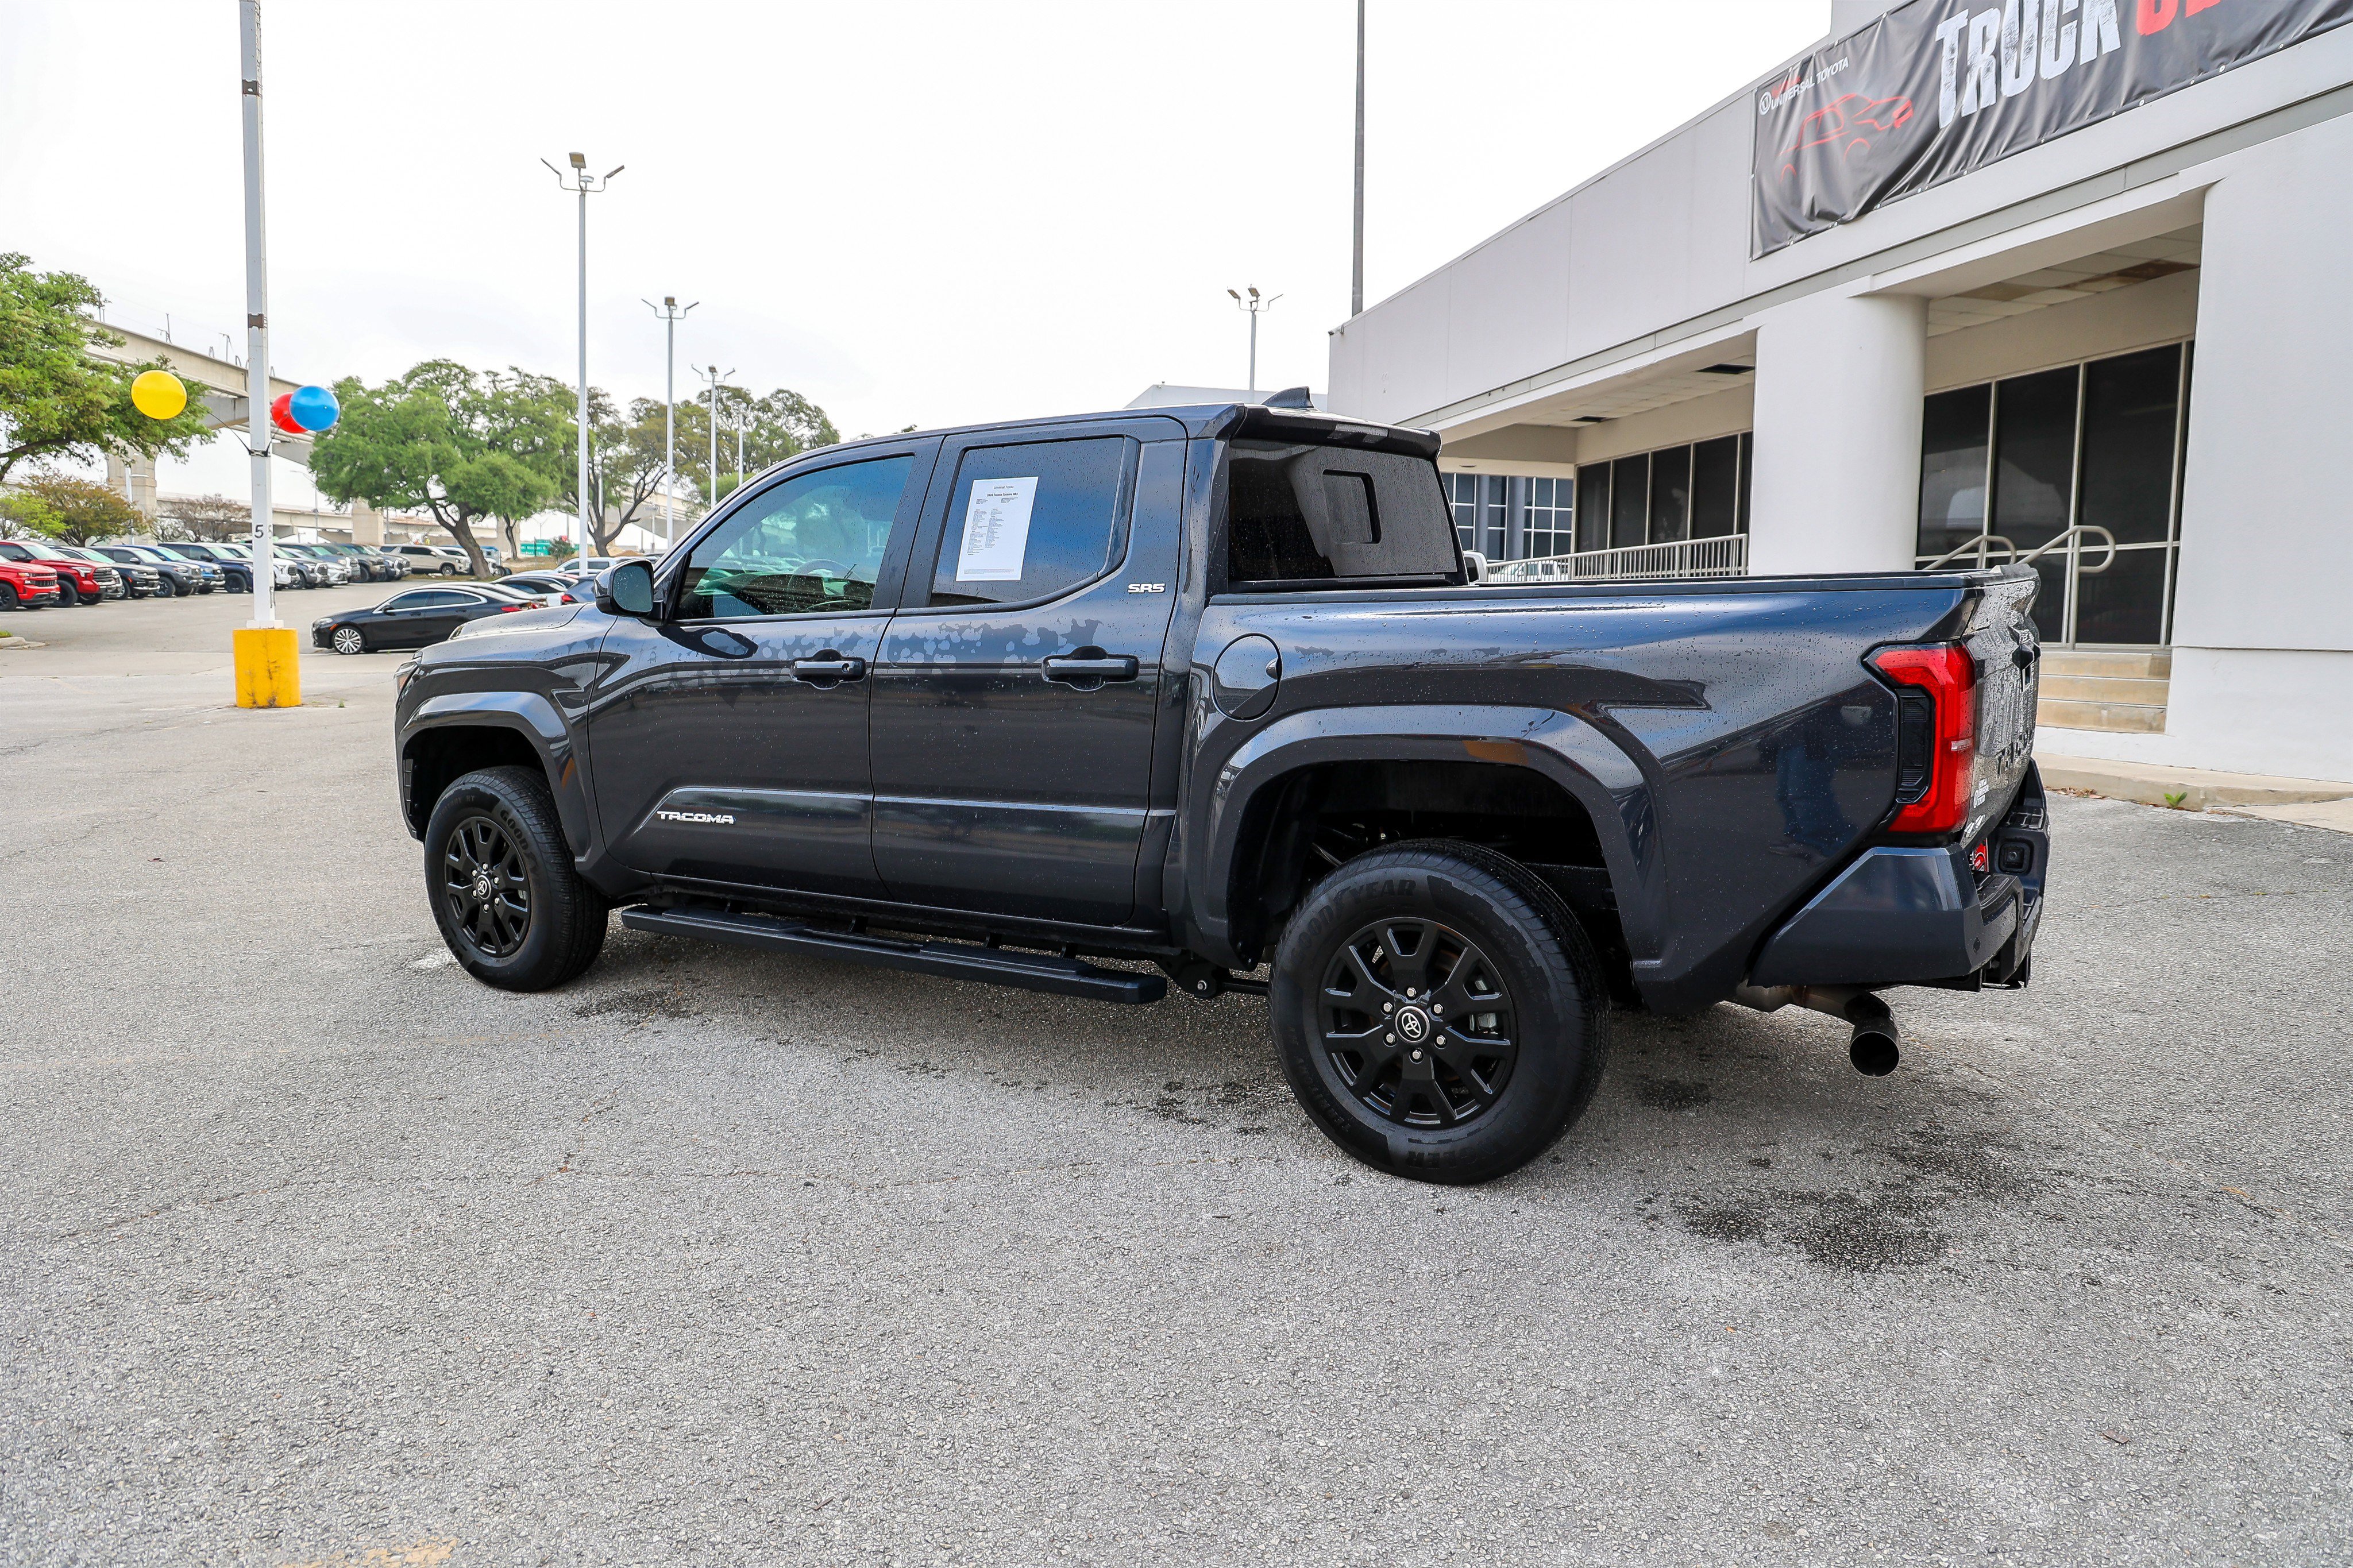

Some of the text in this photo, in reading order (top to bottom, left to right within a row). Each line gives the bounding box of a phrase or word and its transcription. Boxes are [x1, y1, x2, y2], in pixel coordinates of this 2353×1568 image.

[1935, 0, 2122, 130] TRUCK
[1771, 76, 1815, 110] UNIVERSAL
[1815, 56, 1849, 84] TOYOTA
[254, 524, 264, 539] 5
[1127, 583, 1166, 593] SR5
[657, 810, 734, 825] TACOMA
[1291, 879, 1416, 964] GOODYEAR
